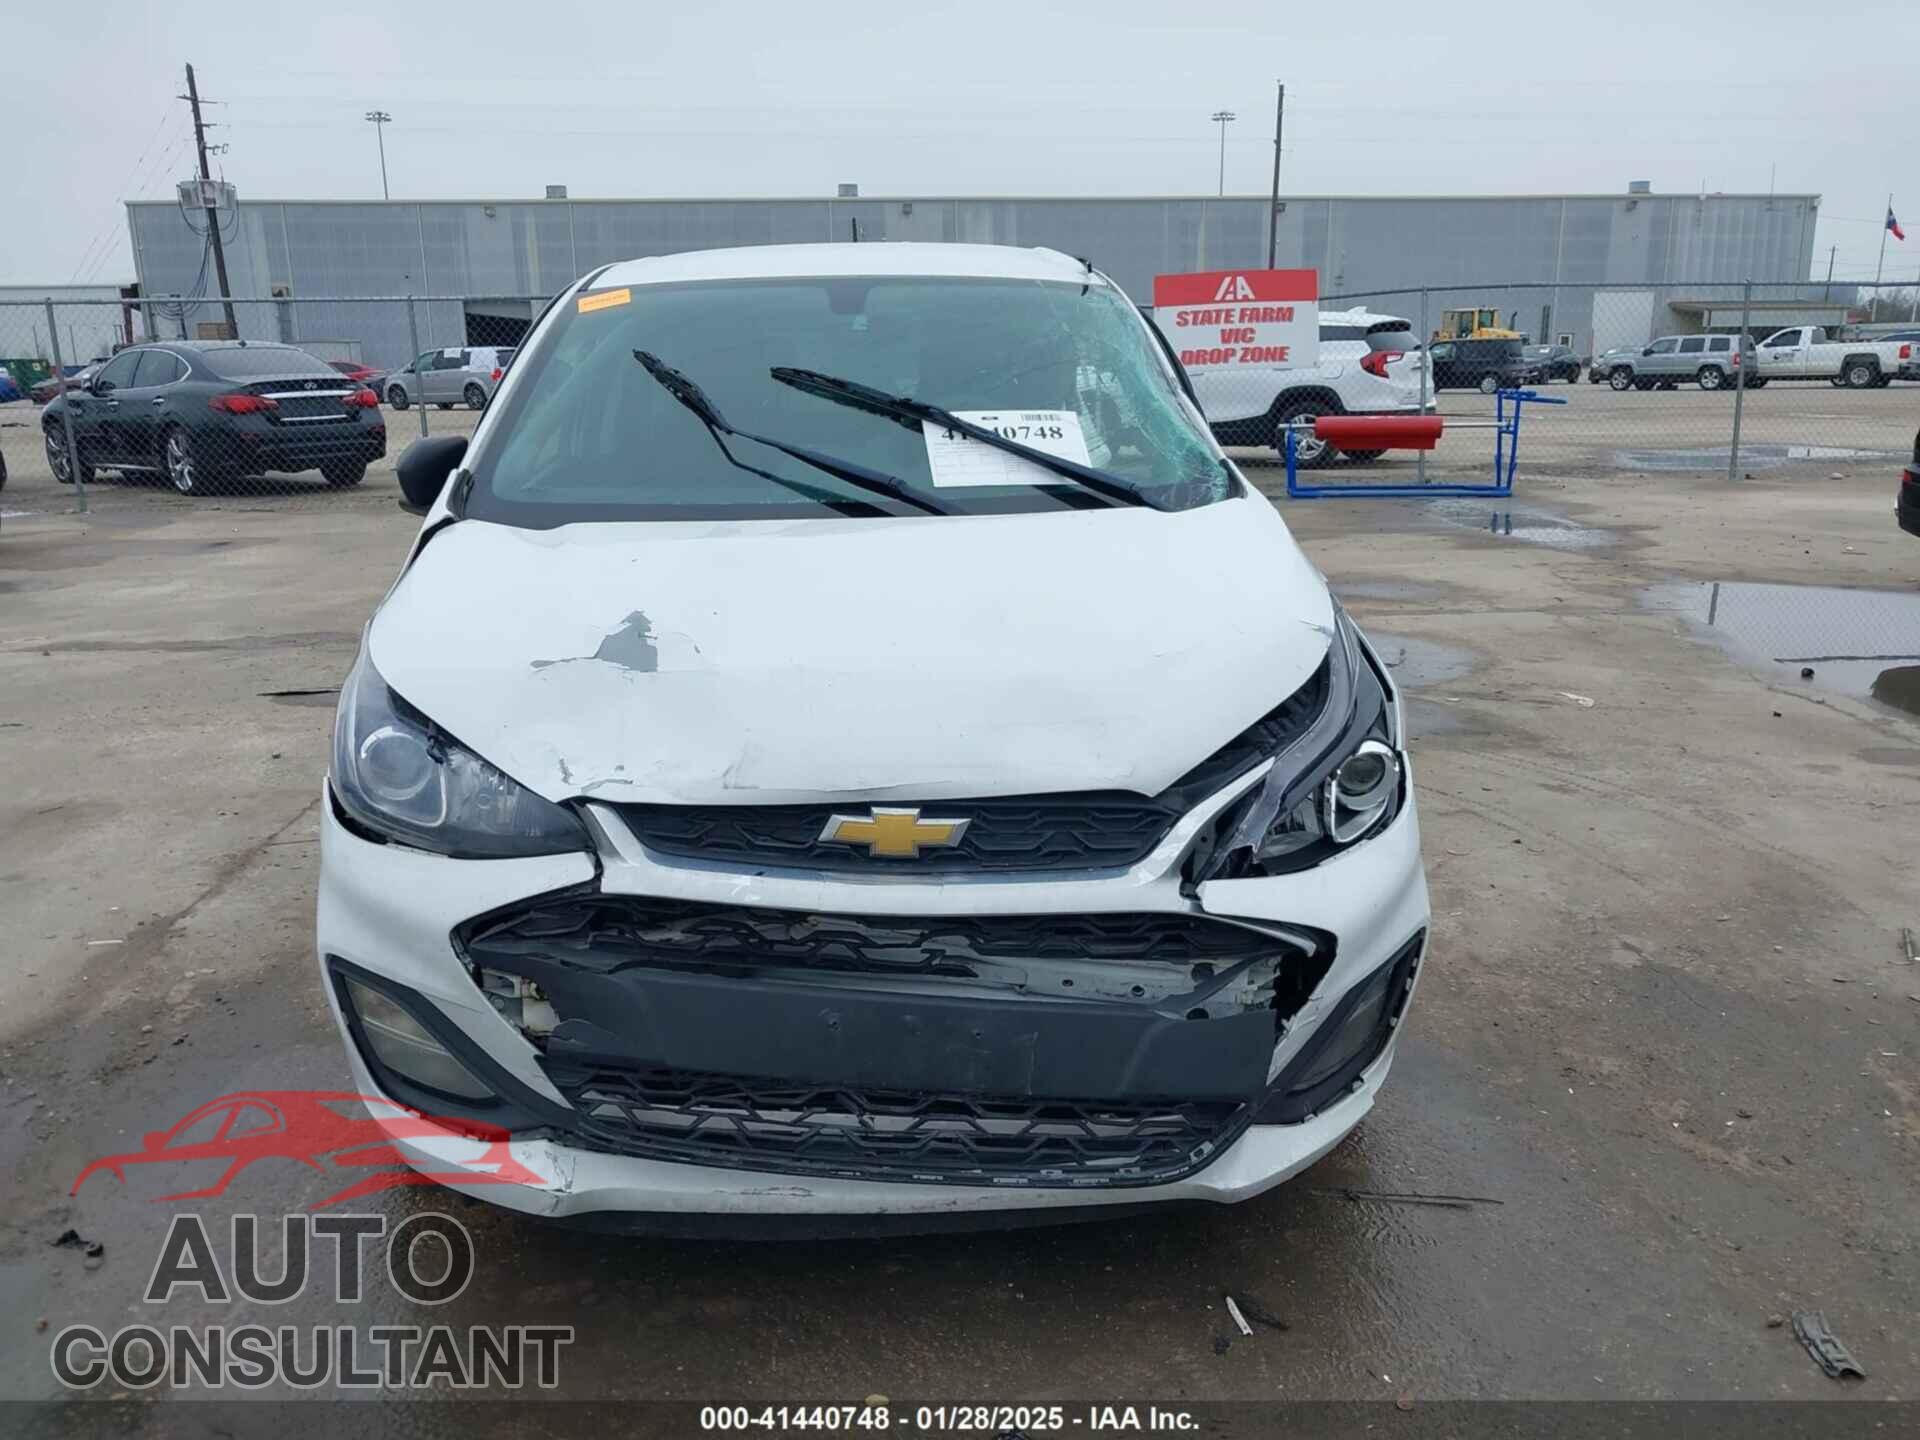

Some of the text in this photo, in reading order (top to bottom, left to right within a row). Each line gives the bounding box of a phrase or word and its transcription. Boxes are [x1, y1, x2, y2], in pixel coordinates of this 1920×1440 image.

[1176, 306, 1294, 327] STATE FARM
[1220, 327, 1256, 344] VIC
[1180, 346, 1291, 367] DROP ZONE
